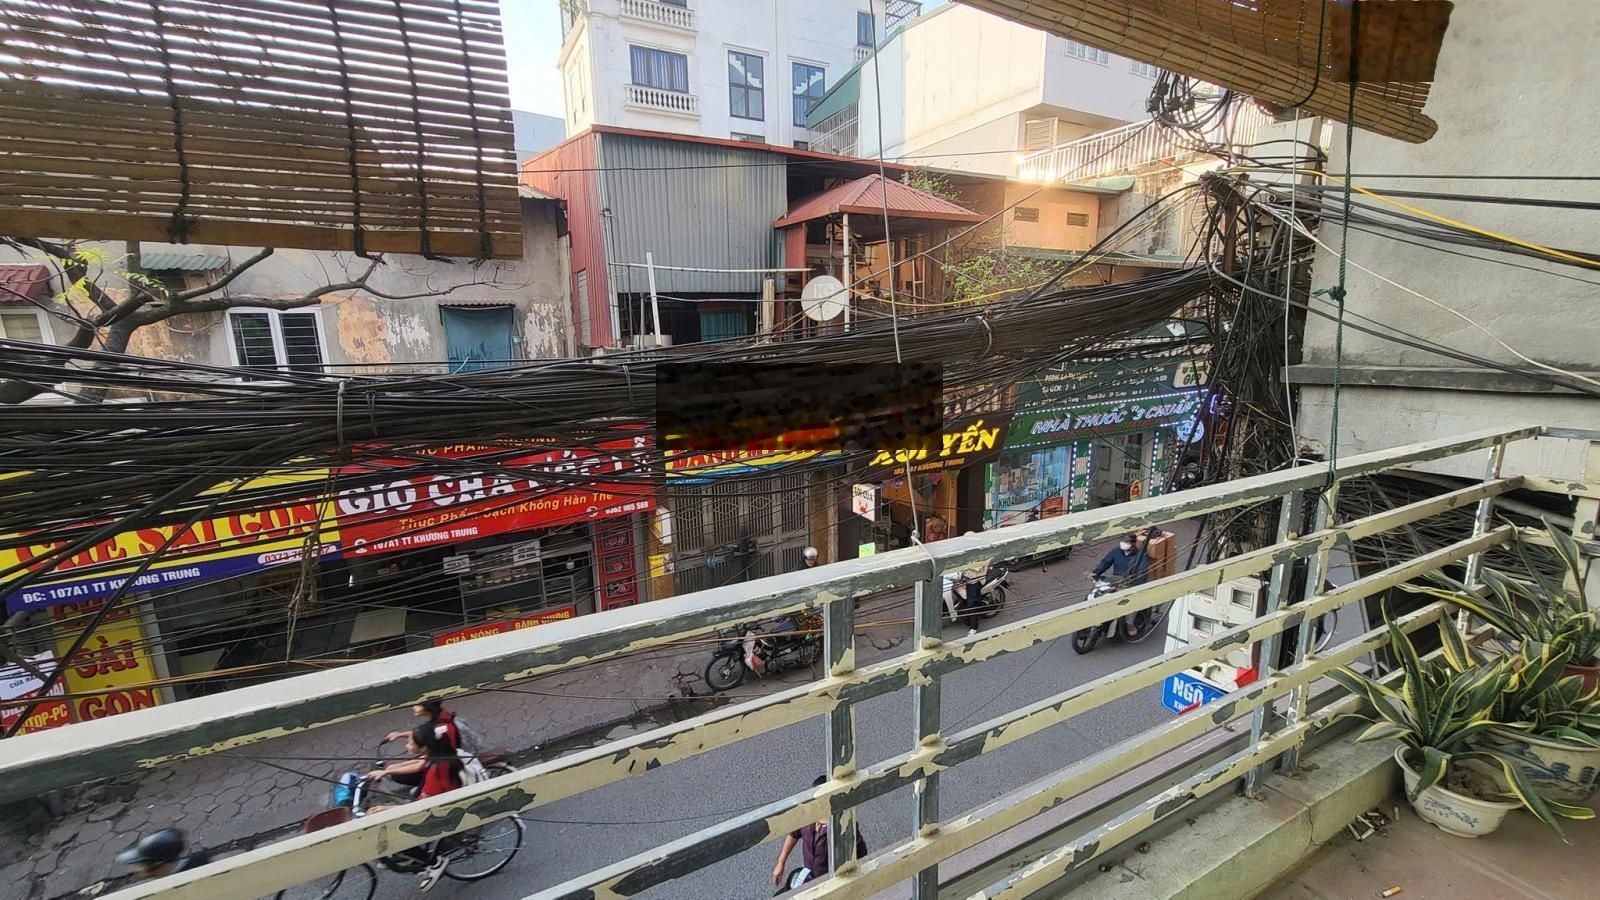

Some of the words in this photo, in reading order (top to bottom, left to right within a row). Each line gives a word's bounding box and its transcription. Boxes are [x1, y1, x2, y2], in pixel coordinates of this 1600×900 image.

[520, 498, 560, 513] Không
[563, 493, 587, 507] Hàn
[401, 535, 412, 546] TT
[413, 530, 449, 543] KHƯƠNG
[451, 527, 478, 538] TRUNG
[22, 592, 46, 604] ĐC:
[50, 584, 89, 600] 107A1
[92, 581, 107, 592] TT
[161, 567, 201, 582] TRUNG
[1172, 676, 1204, 707] NGÕ
